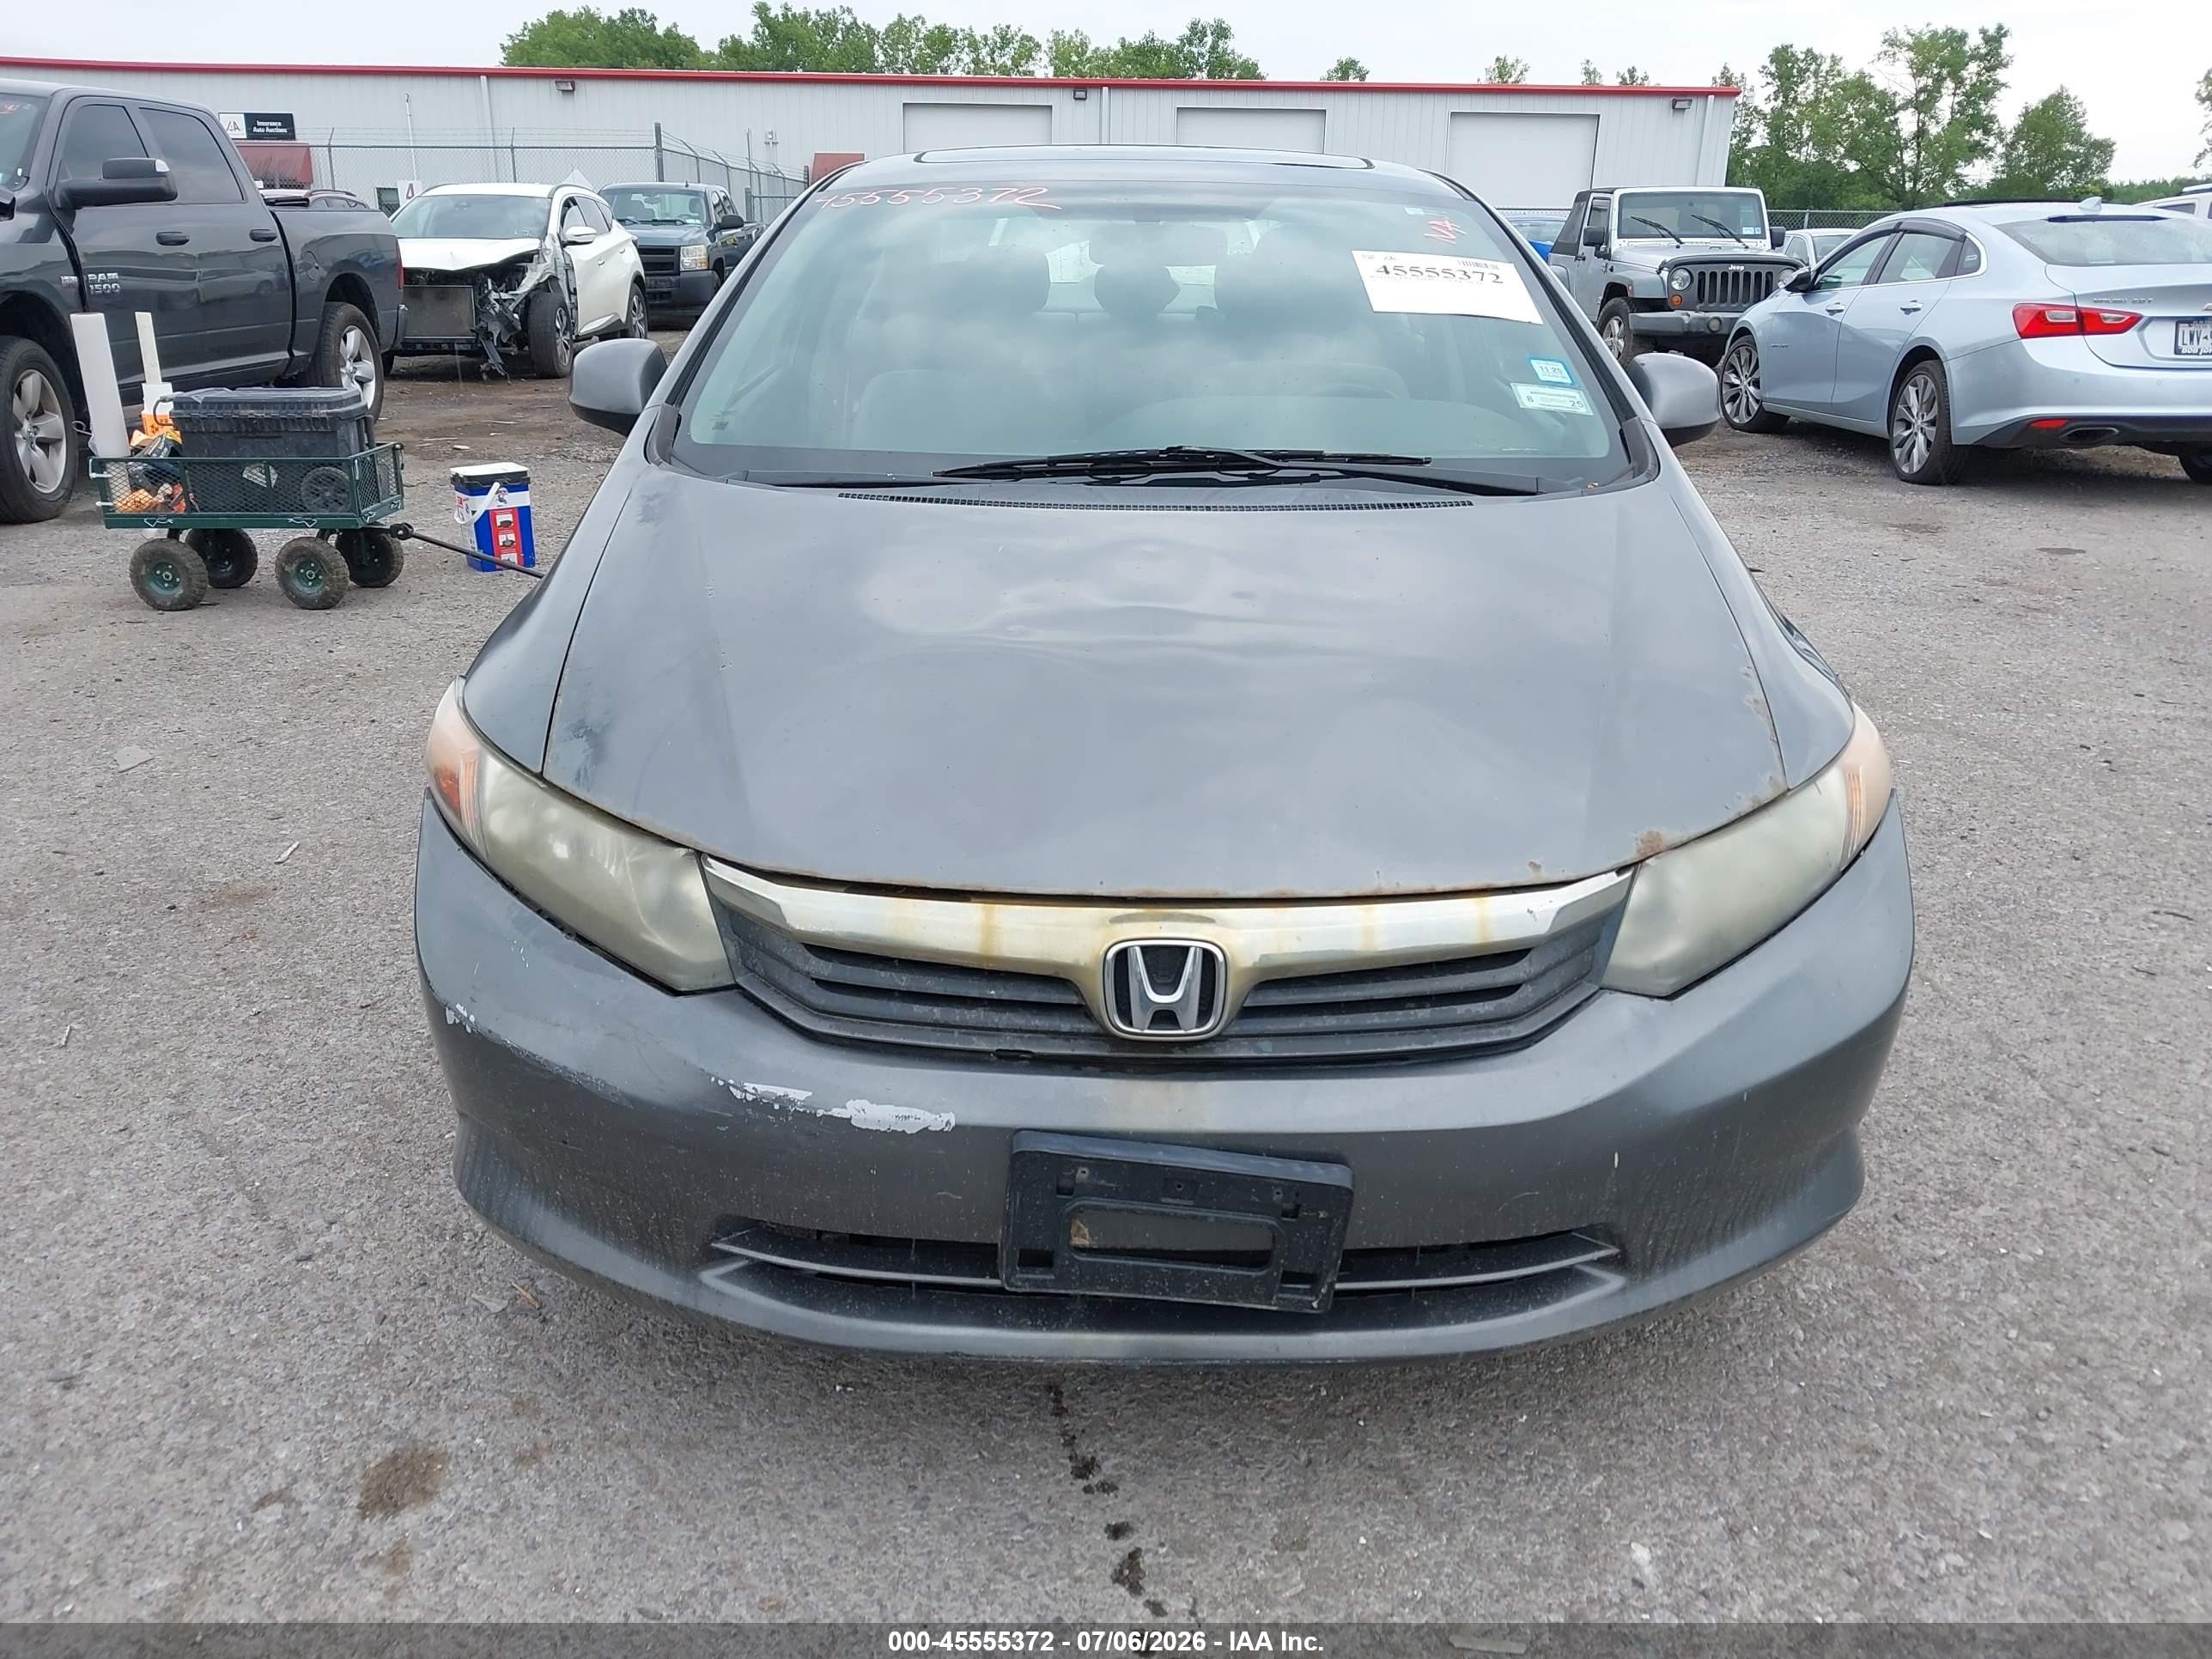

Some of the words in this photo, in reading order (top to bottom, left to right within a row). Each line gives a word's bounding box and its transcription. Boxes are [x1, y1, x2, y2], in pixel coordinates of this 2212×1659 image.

[815, 186, 1063, 210] 45555372
[88, 272, 118, 283] RAM
[1376, 264, 1504, 284] 45555372
[89, 283, 121, 295] 1500
